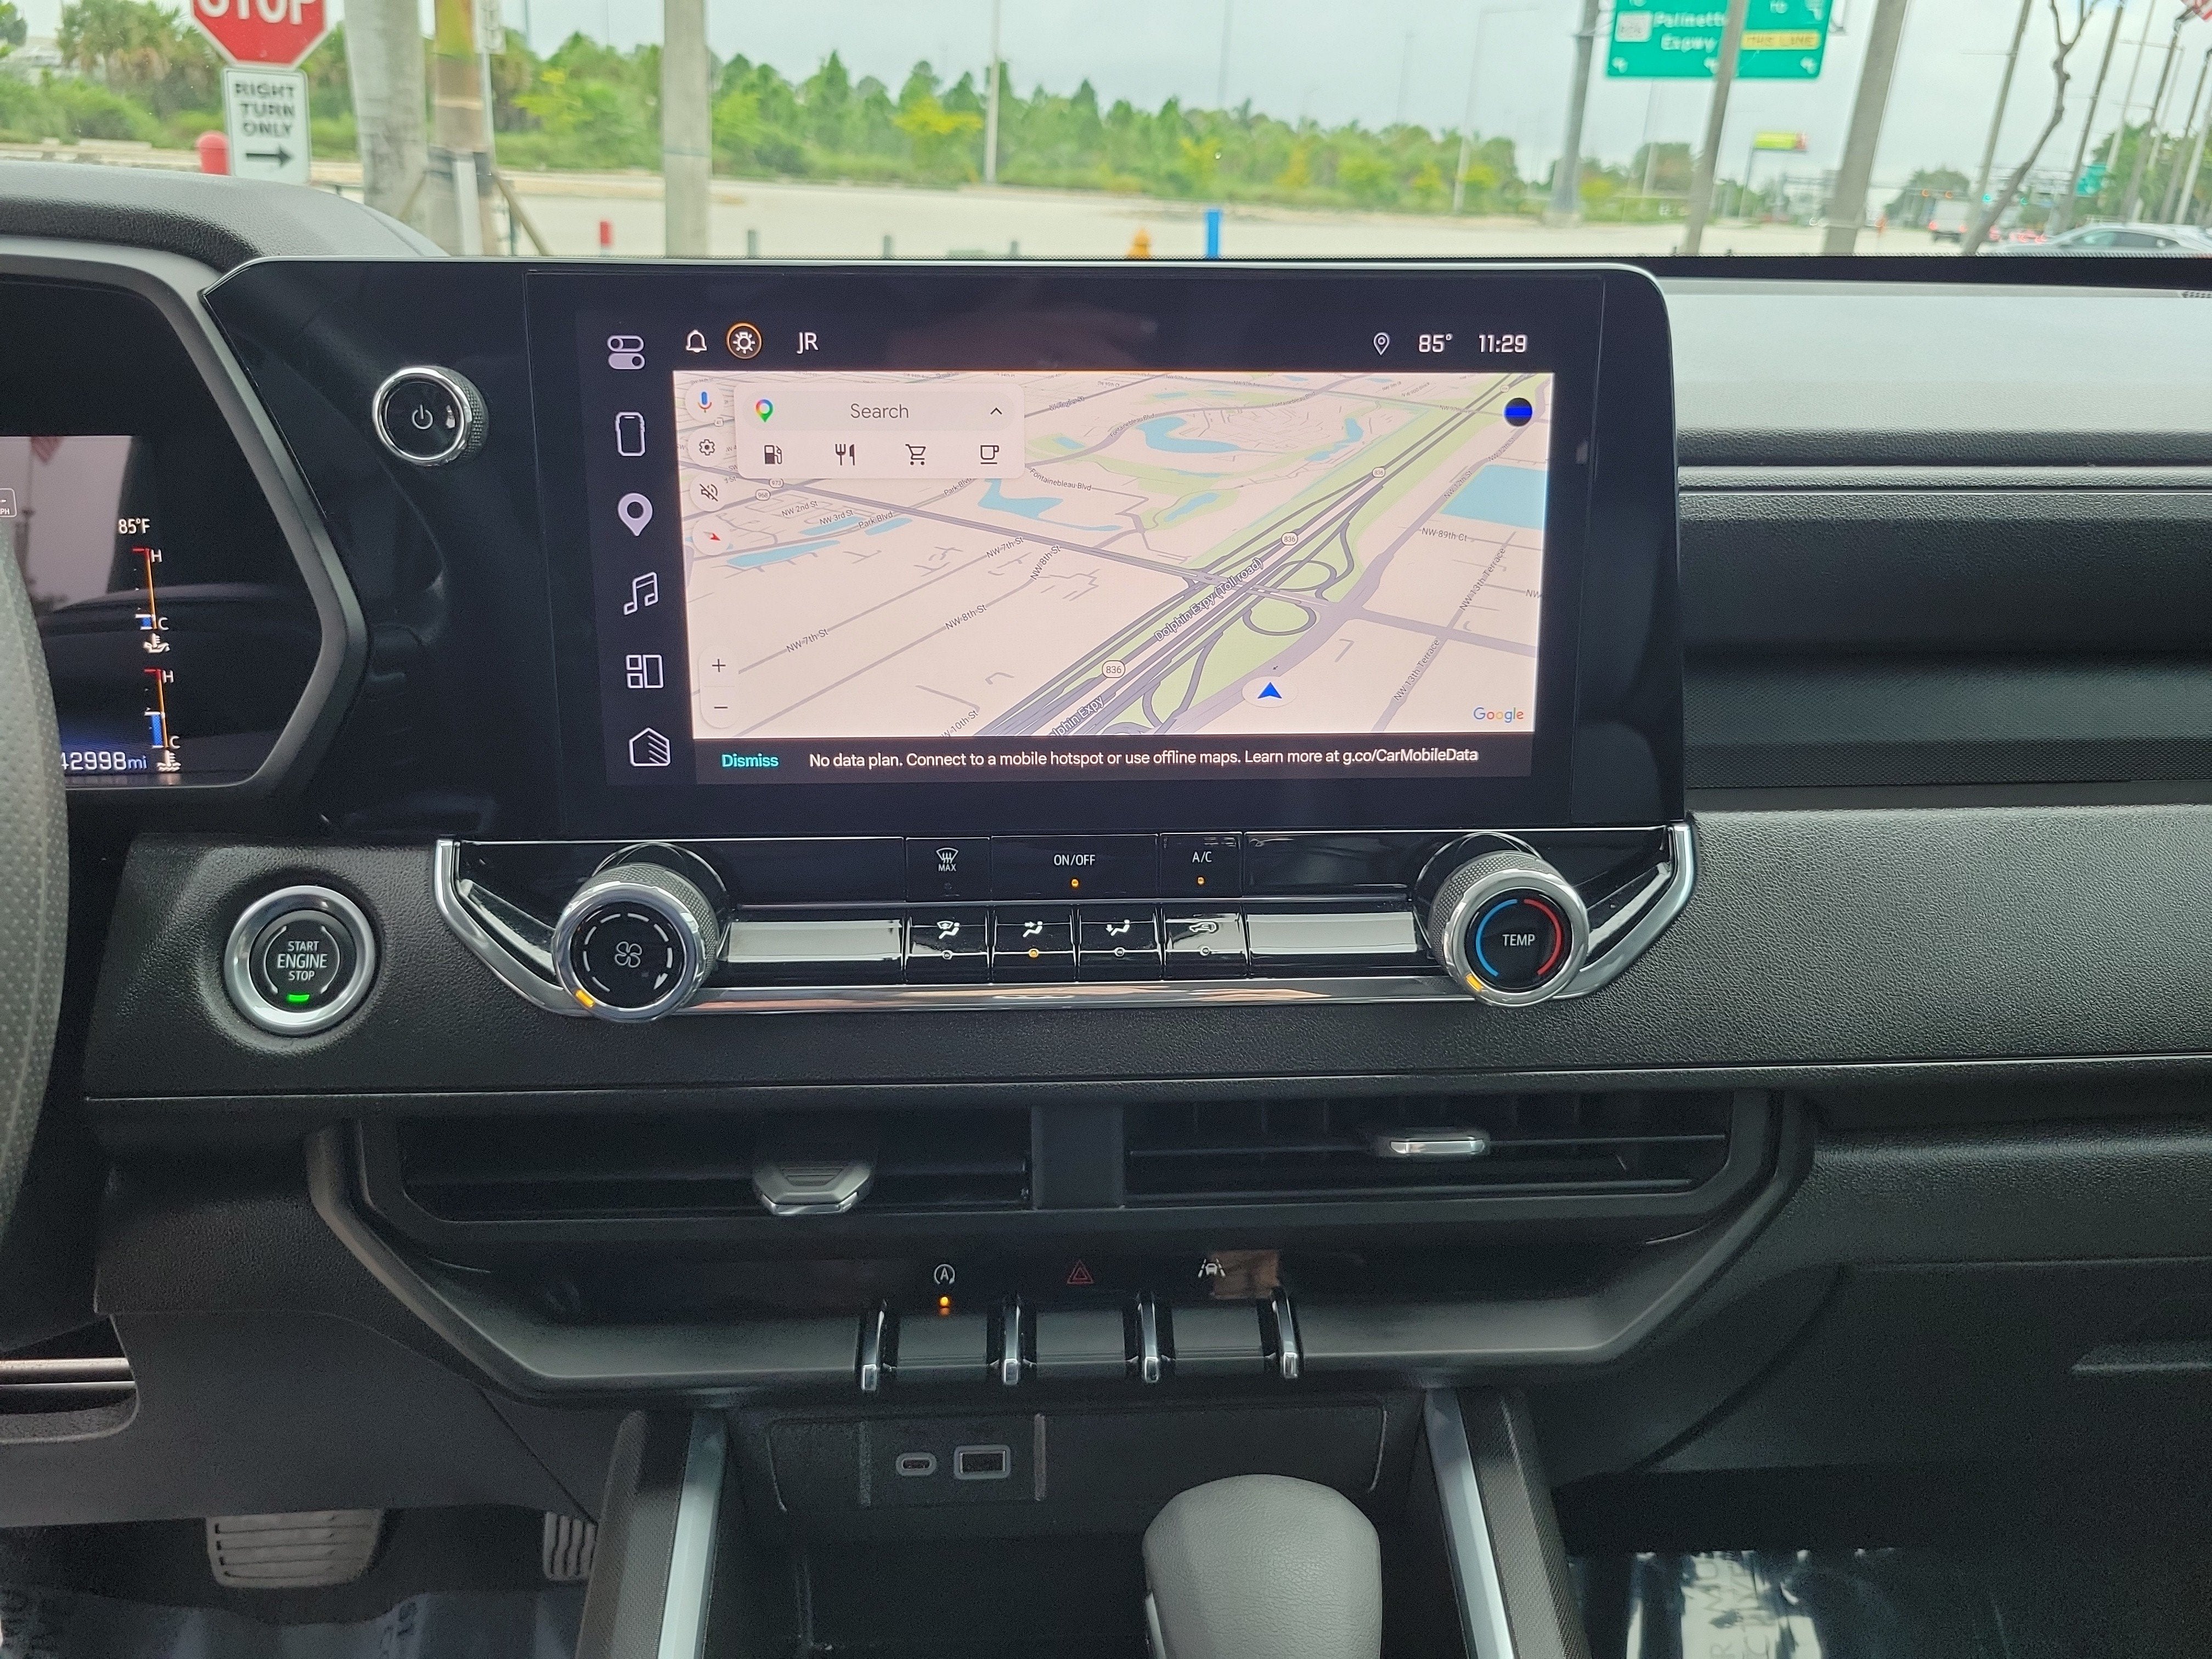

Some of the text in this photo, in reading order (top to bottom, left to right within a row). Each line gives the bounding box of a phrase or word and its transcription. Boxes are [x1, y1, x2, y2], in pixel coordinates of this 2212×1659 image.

[1653, 10, 1726, 27] Palmett
[235, 83, 295, 98] RIGHT
[240, 103, 295, 117] TURN
[243, 122, 292, 136] ONLY
[797, 331, 819, 354] JR
[1419, 333, 1453, 353] 85°
[1478, 334, 1528, 353] 11:29
[850, 403, 910, 419] Search
[1030, 468, 1092, 491] Fontainebleau Blvd
[944, 485, 958, 496] Park
[781, 507, 796, 517] NW
[795, 503, 810, 513] 2nd
[820, 516, 832, 525] NW
[833, 511, 846, 521] 3rd
[118, 517, 150, 534] 85°F
[859, 511, 894, 529] Park Blvd
[1421, 527, 1436, 537] NW
[1438, 530, 1457, 540] 89th
[151, 549, 162, 562] H
[986, 537, 1024, 558] NW 7th St
[1030, 545, 1061, 580] NW 8th St
[1459, 548, 1505, 611] NW 13th Terrace
[1154, 557, 1263, 641] Dolphin Expy (Toll road)
[158, 617, 170, 630] C
[945, 604, 988, 630] NW 8th St
[786, 628, 829, 653] NW 7th St
[162, 670, 174, 683] H
[1106, 665, 1122, 674] 836
[1393, 639, 1440, 702] NW 13th Terrace
[951, 718, 970, 734] 10th
[968, 710, 979, 720] St
[1049, 695, 1105, 736] lphin Expy
[1474, 707, 1525, 723] Google
[170, 736, 181, 749] C
[721, 753, 779, 768] Dismiss
[809, 747, 1479, 770] No data plan. Connect to a mobile hotspot or use offline maps. Learn more at g.co/CarMobileData
[1053, 854, 1096, 866] ON/OFF
[1192, 851, 1212, 864] A/C
[938, 864, 957, 872] MAX
[287, 940, 320, 951] START
[1503, 934, 1536, 946] TEMP
[277, 953, 328, 969] ENGINE
[288, 970, 315, 981] STOP
